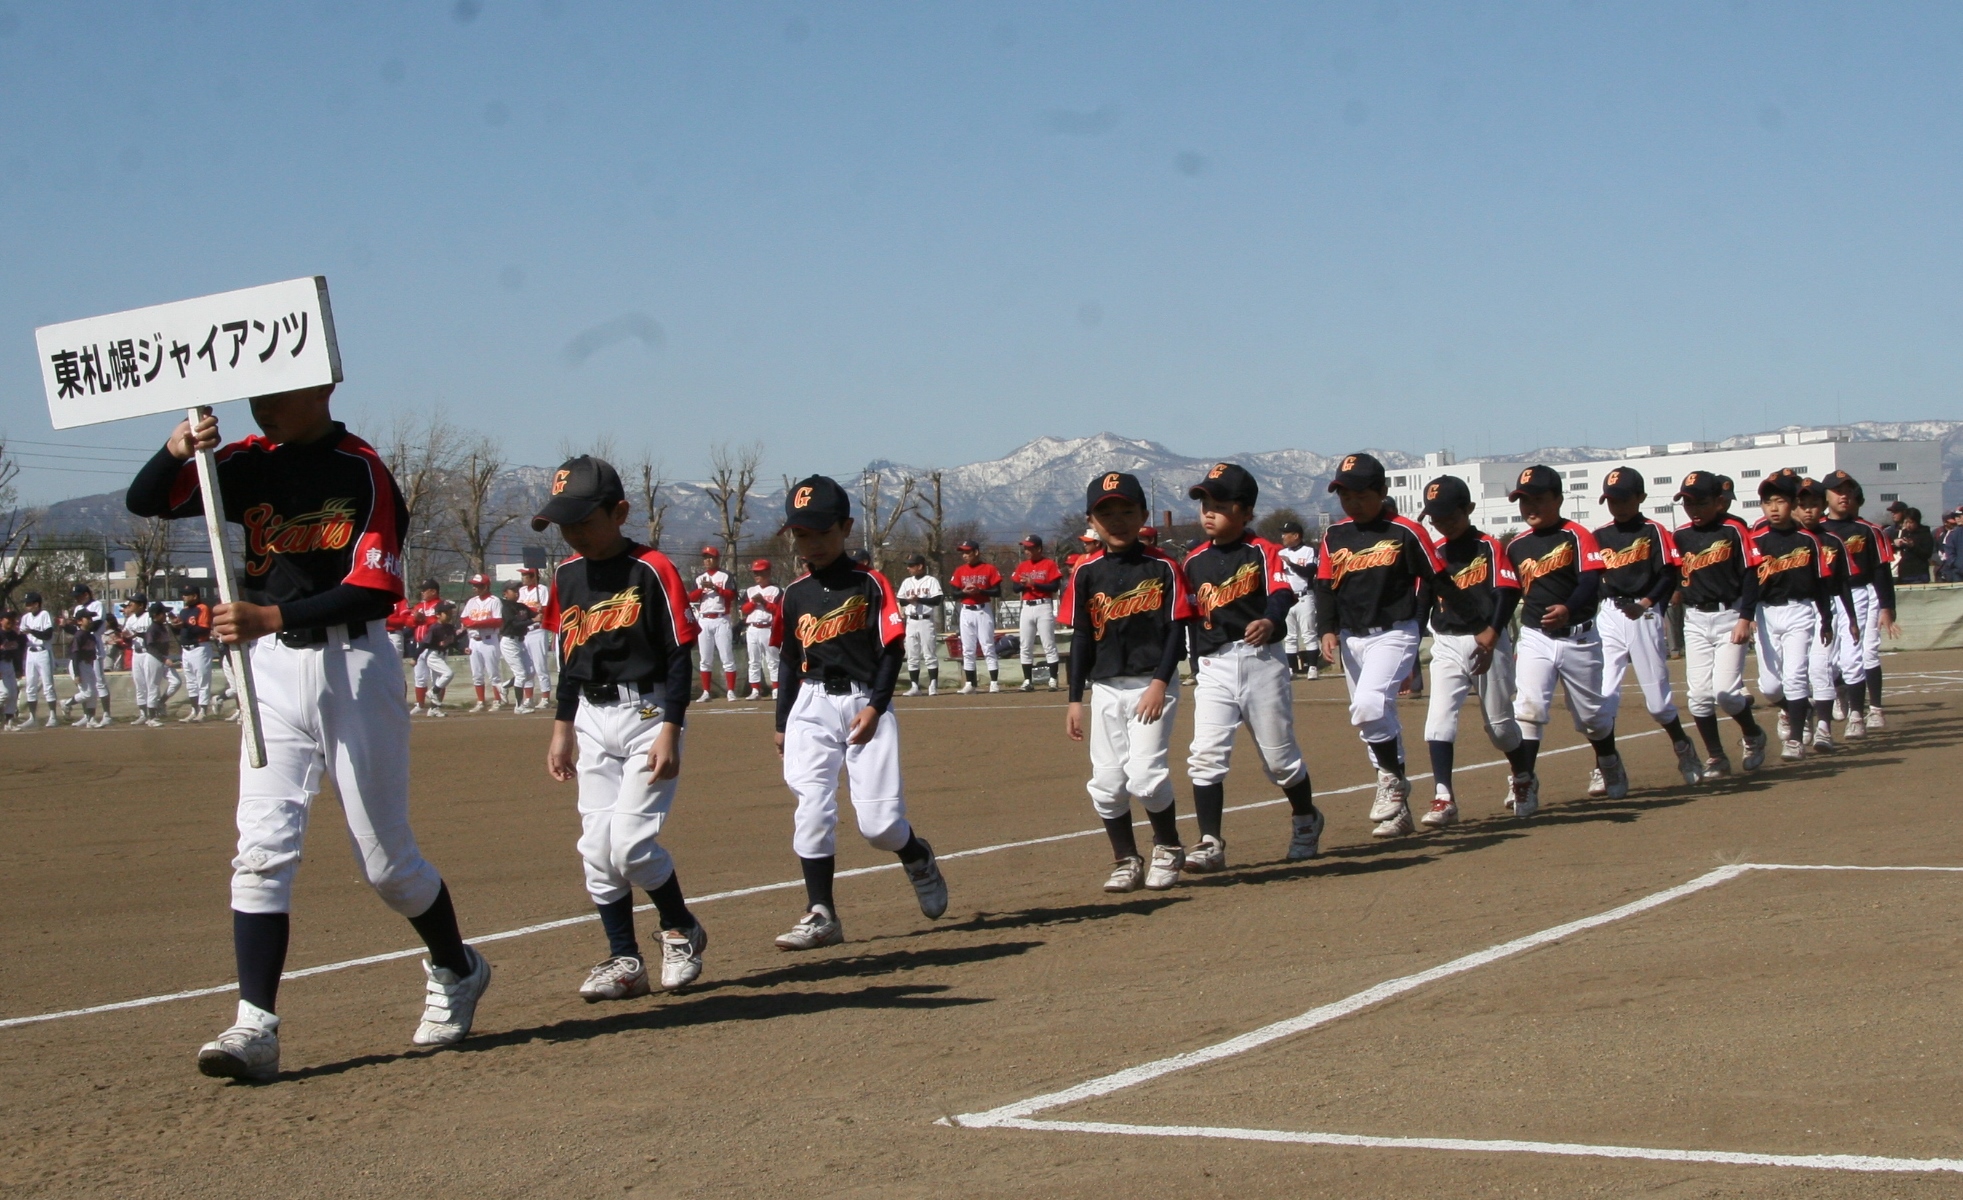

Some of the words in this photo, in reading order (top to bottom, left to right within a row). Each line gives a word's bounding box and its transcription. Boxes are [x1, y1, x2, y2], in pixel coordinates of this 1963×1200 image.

[51, 311, 308, 400] 東札幌ジャイアンツ
[1208, 463, 1228, 479] G
[1341, 456, 1357, 472] G
[552, 470, 570, 495] G
[1103, 473, 1120, 491] G
[1520, 469, 1533, 485] G
[1607, 471, 1620, 486] G
[1685, 473, 1698, 487] G
[794, 486, 813, 509] G
[1427, 484, 1439, 500] G
[244, 502, 355, 576] Giants
[1331, 545, 1401, 590] Giants
[1197, 571, 1260, 630] Giants
[1086, 586, 1165, 641] Giants
[561, 599, 643, 665] Giants
